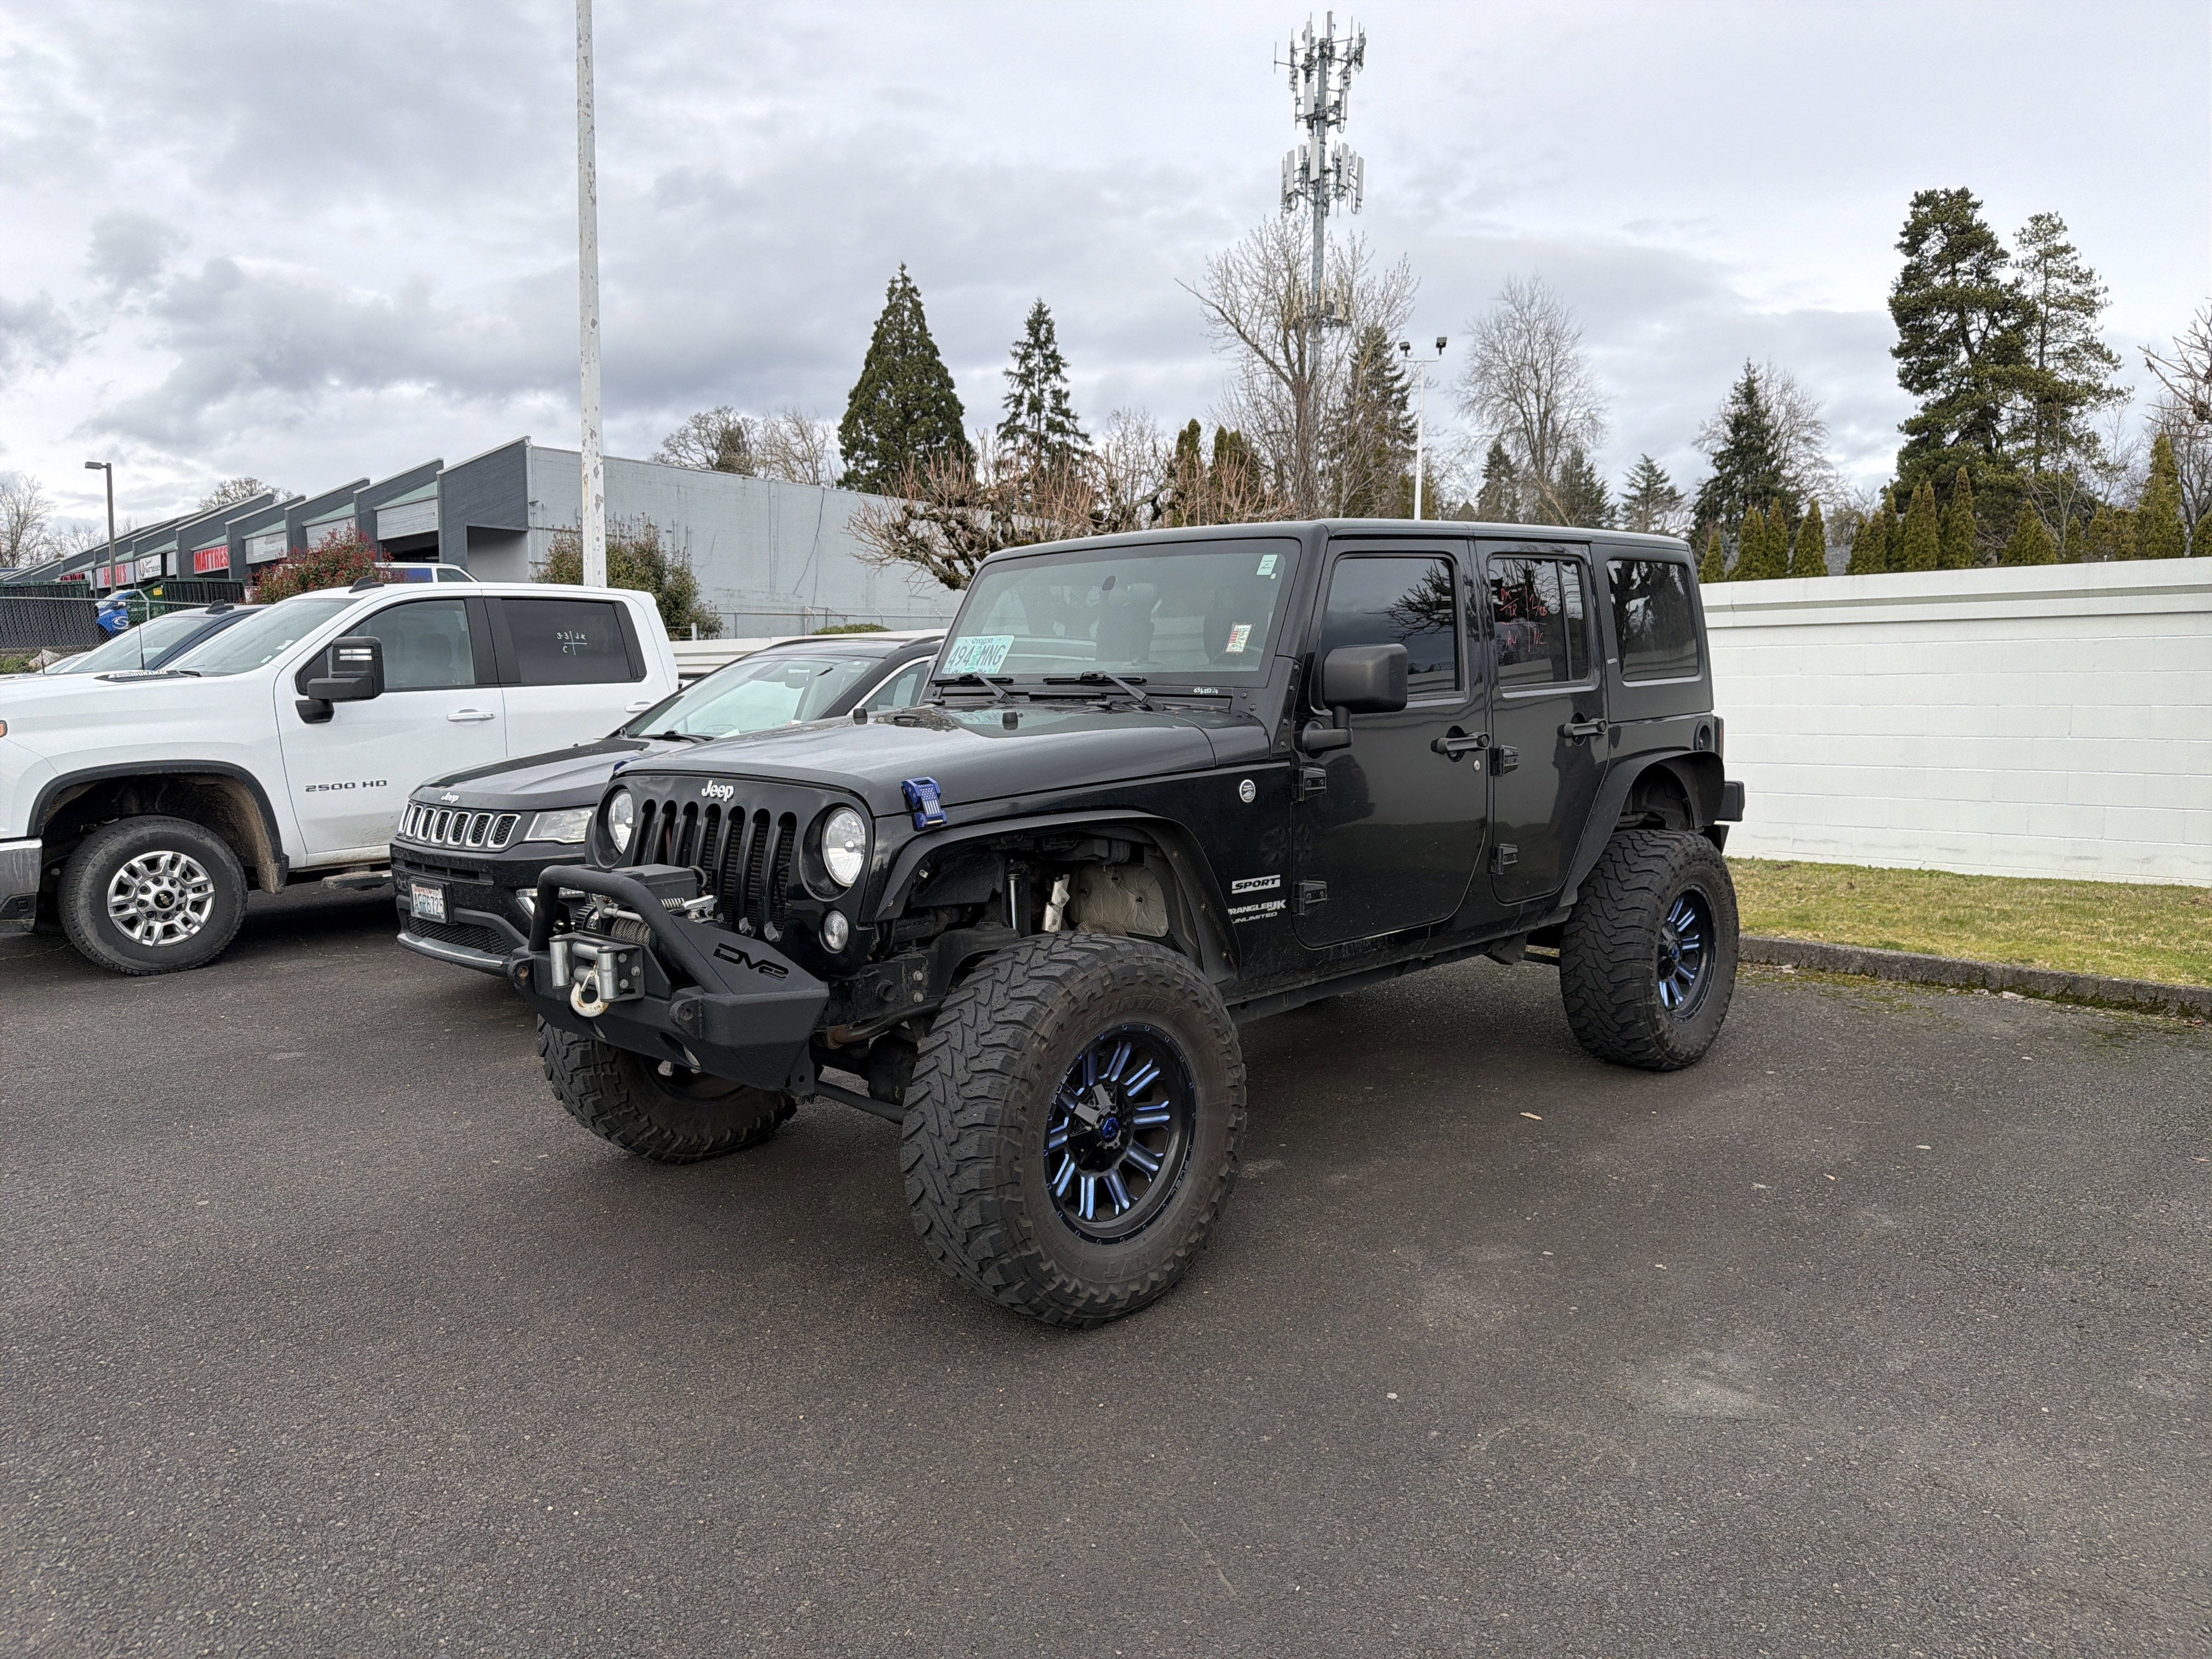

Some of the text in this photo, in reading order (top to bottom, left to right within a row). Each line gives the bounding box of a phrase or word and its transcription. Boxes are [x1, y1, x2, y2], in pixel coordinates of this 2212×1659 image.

[195, 546, 229, 572] MATTRES
[947, 645, 1006, 667] 494 MNG
[305, 780, 387, 792] 2500 HD
[701, 780, 735, 802] Jeep
[441, 792, 460, 804] Jeep
[1233, 878, 1279, 890] SPORT
[1232, 911, 1278, 924] UNLIMITED
[1171, 1160, 1189, 1195] FUEL
